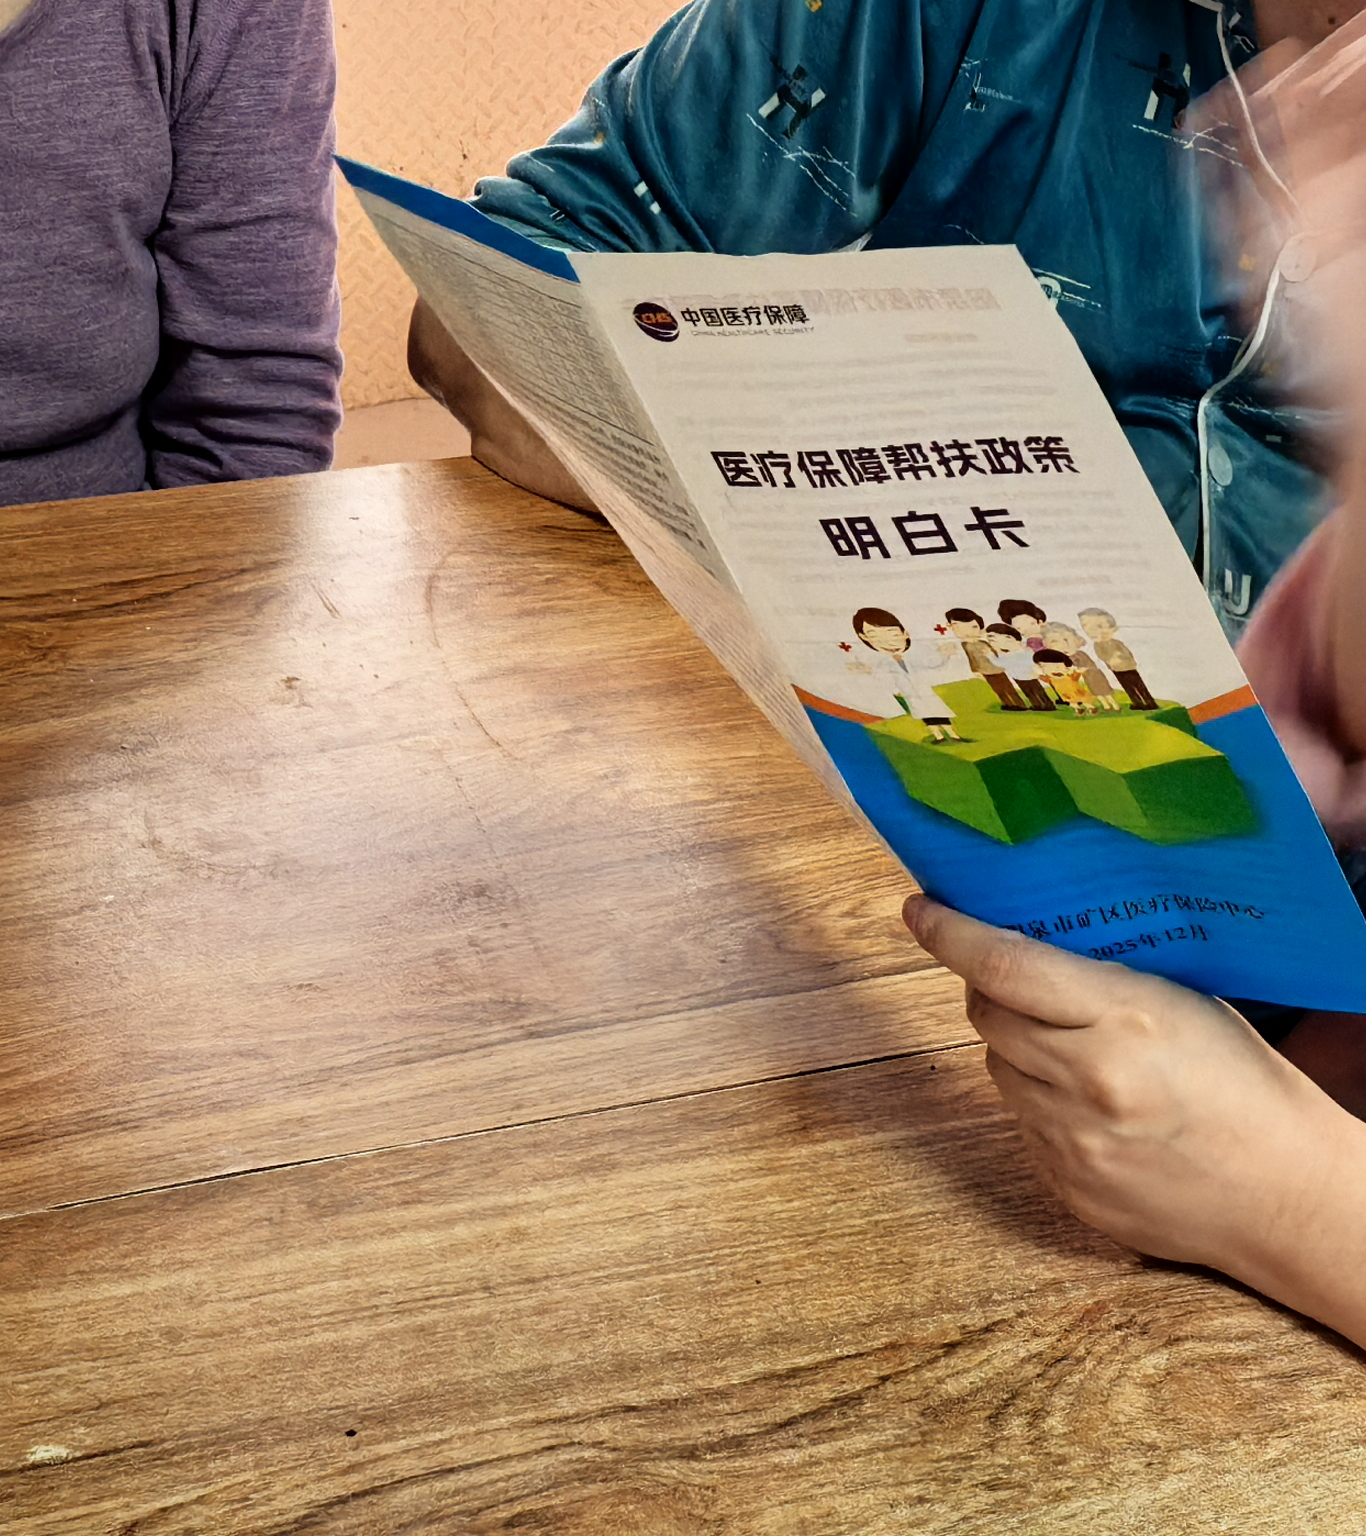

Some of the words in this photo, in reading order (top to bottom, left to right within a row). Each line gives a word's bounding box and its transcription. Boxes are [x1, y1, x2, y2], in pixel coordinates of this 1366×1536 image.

[681, 304, 811, 327] 中国医疗保障
[710, 436, 1080, 488] 医疗保障帮扶政策
[819, 506, 1030, 560] 明白卡
